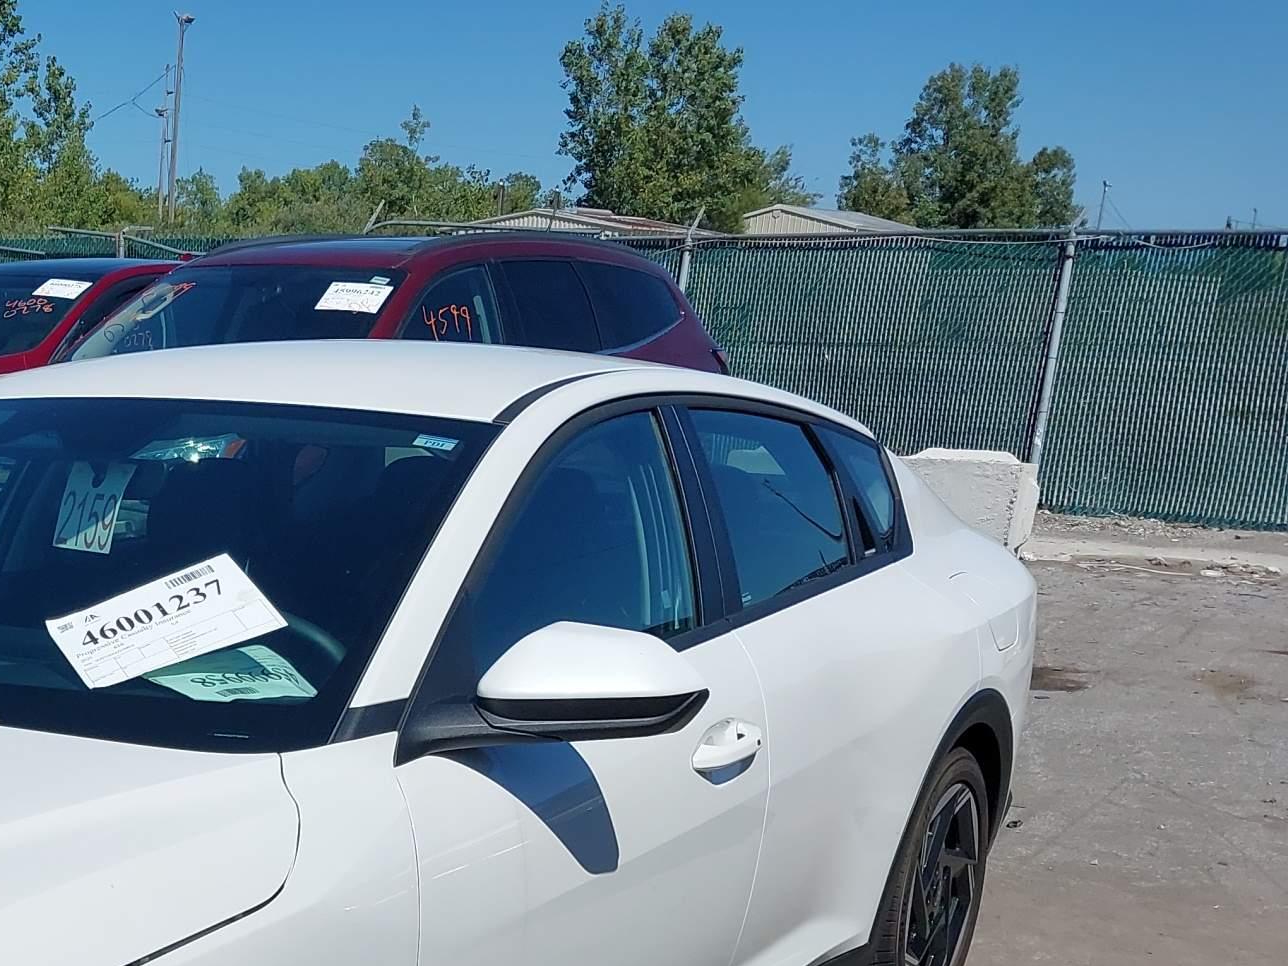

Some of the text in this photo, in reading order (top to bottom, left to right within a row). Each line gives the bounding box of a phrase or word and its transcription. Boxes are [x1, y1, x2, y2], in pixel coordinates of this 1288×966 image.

[422, 304, 473, 342] 4599
[54, 490, 118, 551] 2159
[82, 578, 224, 646] 46001237
